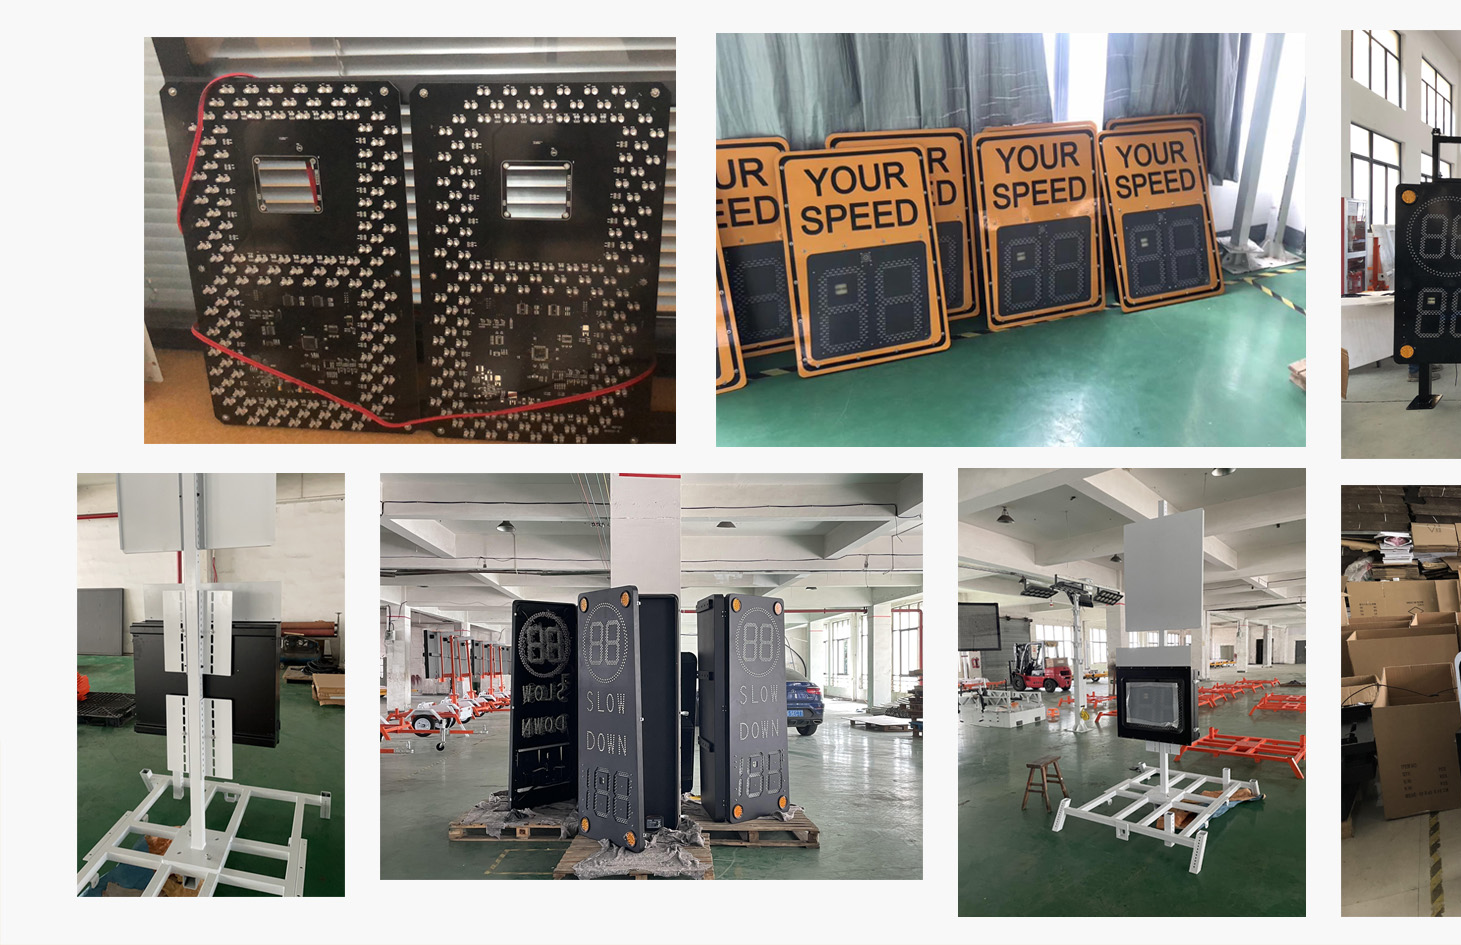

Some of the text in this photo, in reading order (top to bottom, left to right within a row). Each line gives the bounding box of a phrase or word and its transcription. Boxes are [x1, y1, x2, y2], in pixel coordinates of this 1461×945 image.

[996, 141, 1080, 174] YOUR
[1115, 140, 1188, 169] YOUR
[803, 161, 908, 197] YOUR
[992, 176, 1087, 210] SPEED
[1115, 168, 1196, 199] SPEED
[801, 198, 919, 236] SPEED
[586, 690, 625, 714] SLOW
[739, 684, 778, 705] SLOW
[586, 730, 627, 757] DOWN
[739, 718, 779, 741] DOWN
